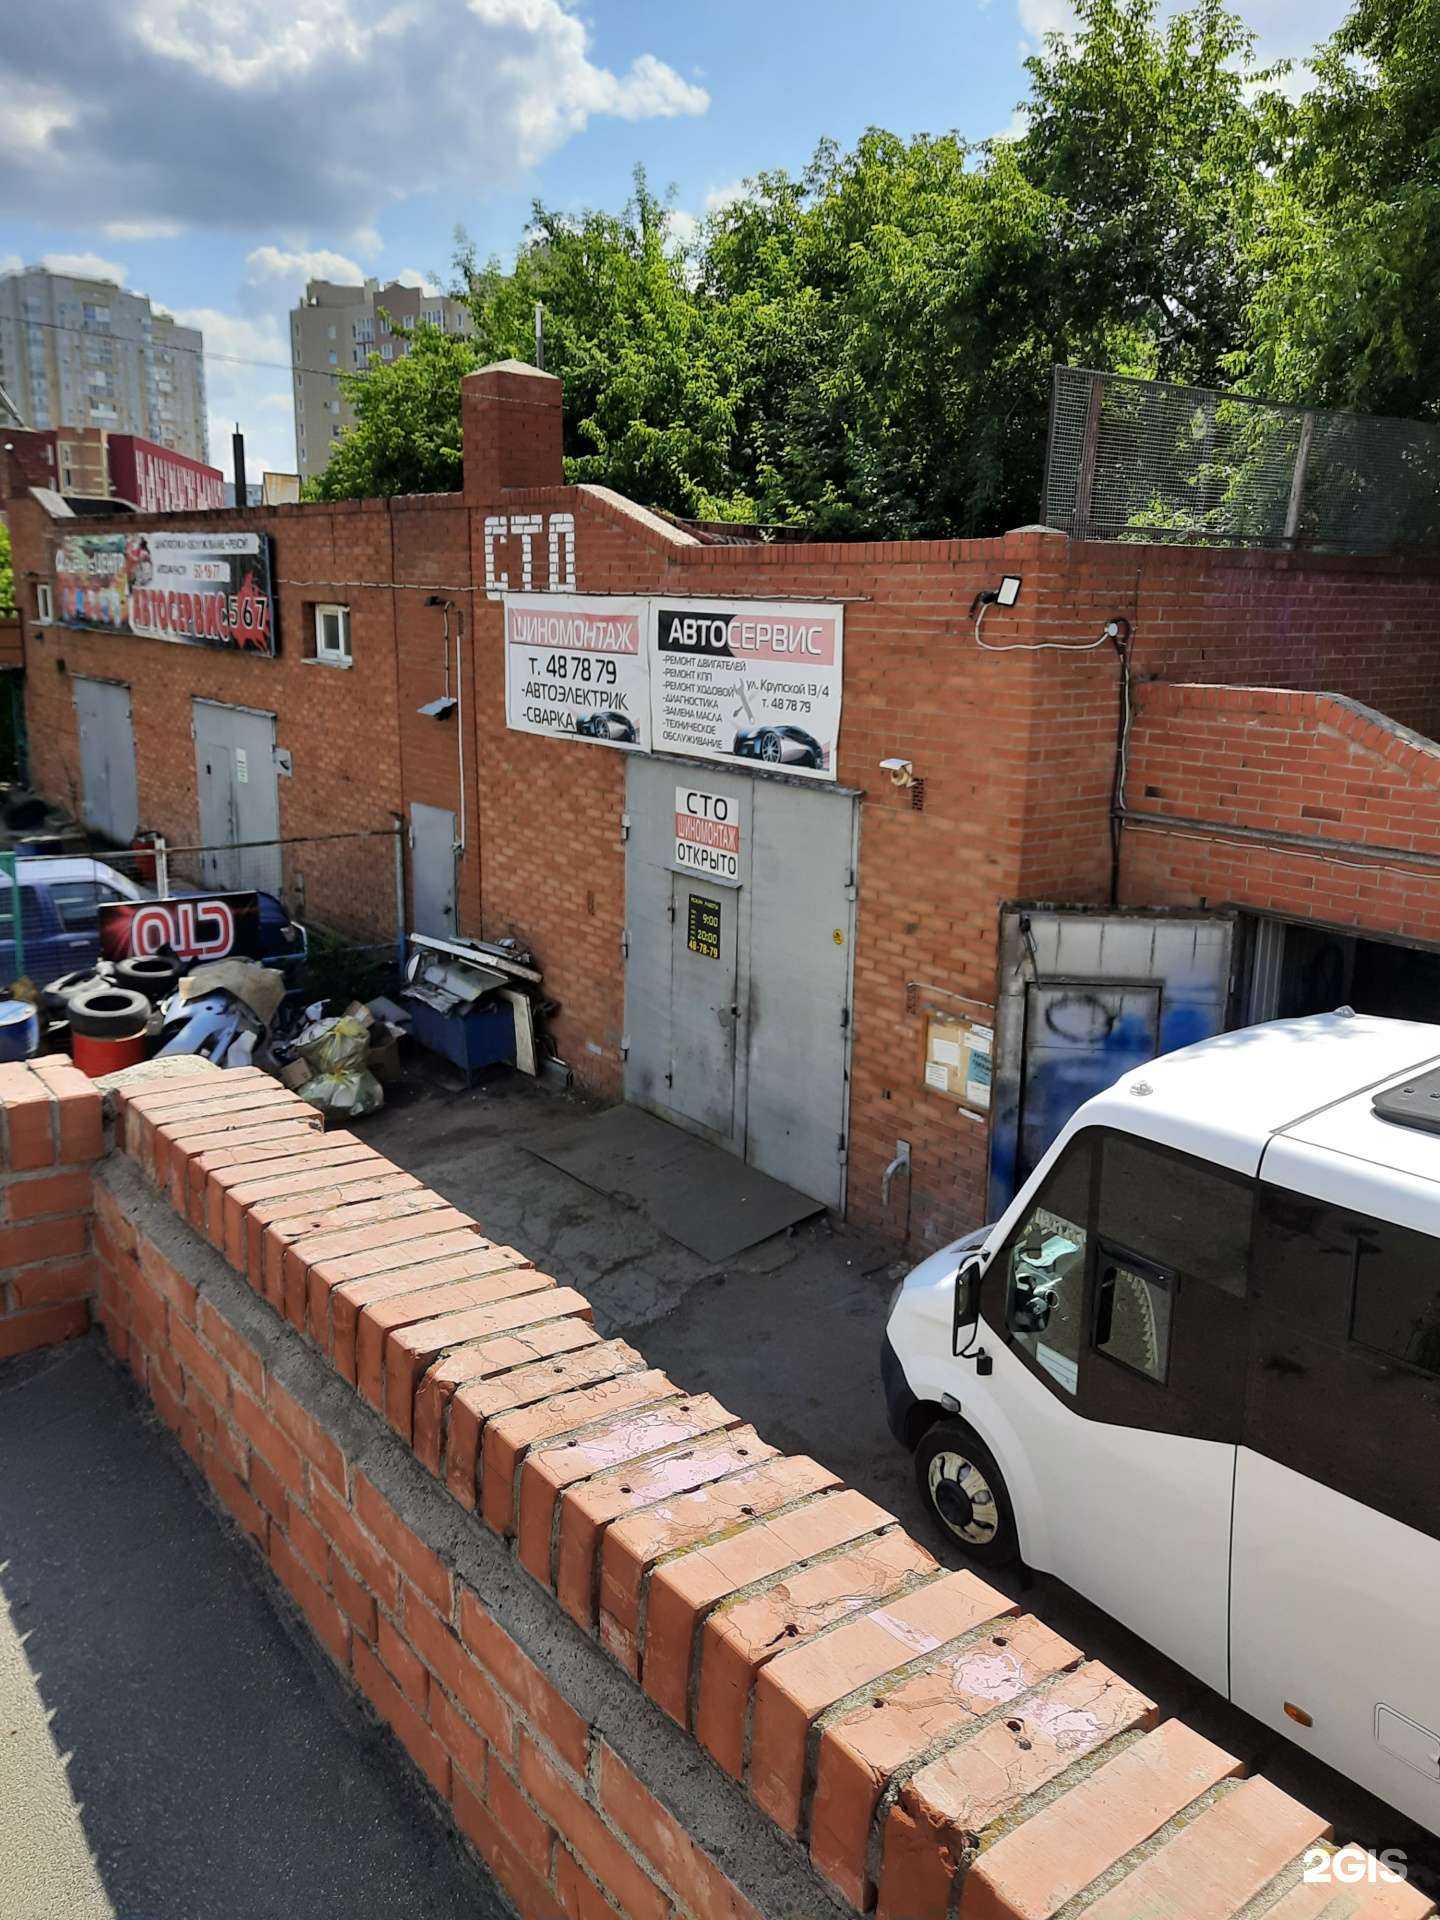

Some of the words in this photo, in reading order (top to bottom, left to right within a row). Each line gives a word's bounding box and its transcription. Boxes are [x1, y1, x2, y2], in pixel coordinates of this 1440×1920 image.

[485, 513, 576, 600] СТО
[132, 587, 230, 641] АВТОСЕРВИС
[229, 595, 267, 630] 567
[512, 615, 634, 650] ШИНОМОНТАЖ
[668, 617, 823, 655] АВТОСЕРВИС
[697, 658, 746, 672] ДВИГАТЕЛЕЙ
[697, 671, 712, 681] КПП
[521, 681, 629, 711] -АВТОЭЛЕКТРИК
[697, 684, 735, 698] ХОДОВОЙ
[746, 680, 759, 691] ул.
[760, 679, 805, 697] Крупской
[522, 706, 576, 730] -СВАРКА
[696, 710, 723, 722] МАСЛА
[662, 731, 722, 749] ОБСЛУЖИВАНИЕ
[686, 792, 728, 821] СТО
[678, 814, 736, 851] ШИНОМОНТАЖ
[678, 842, 736, 875] ОТКРЫТО
